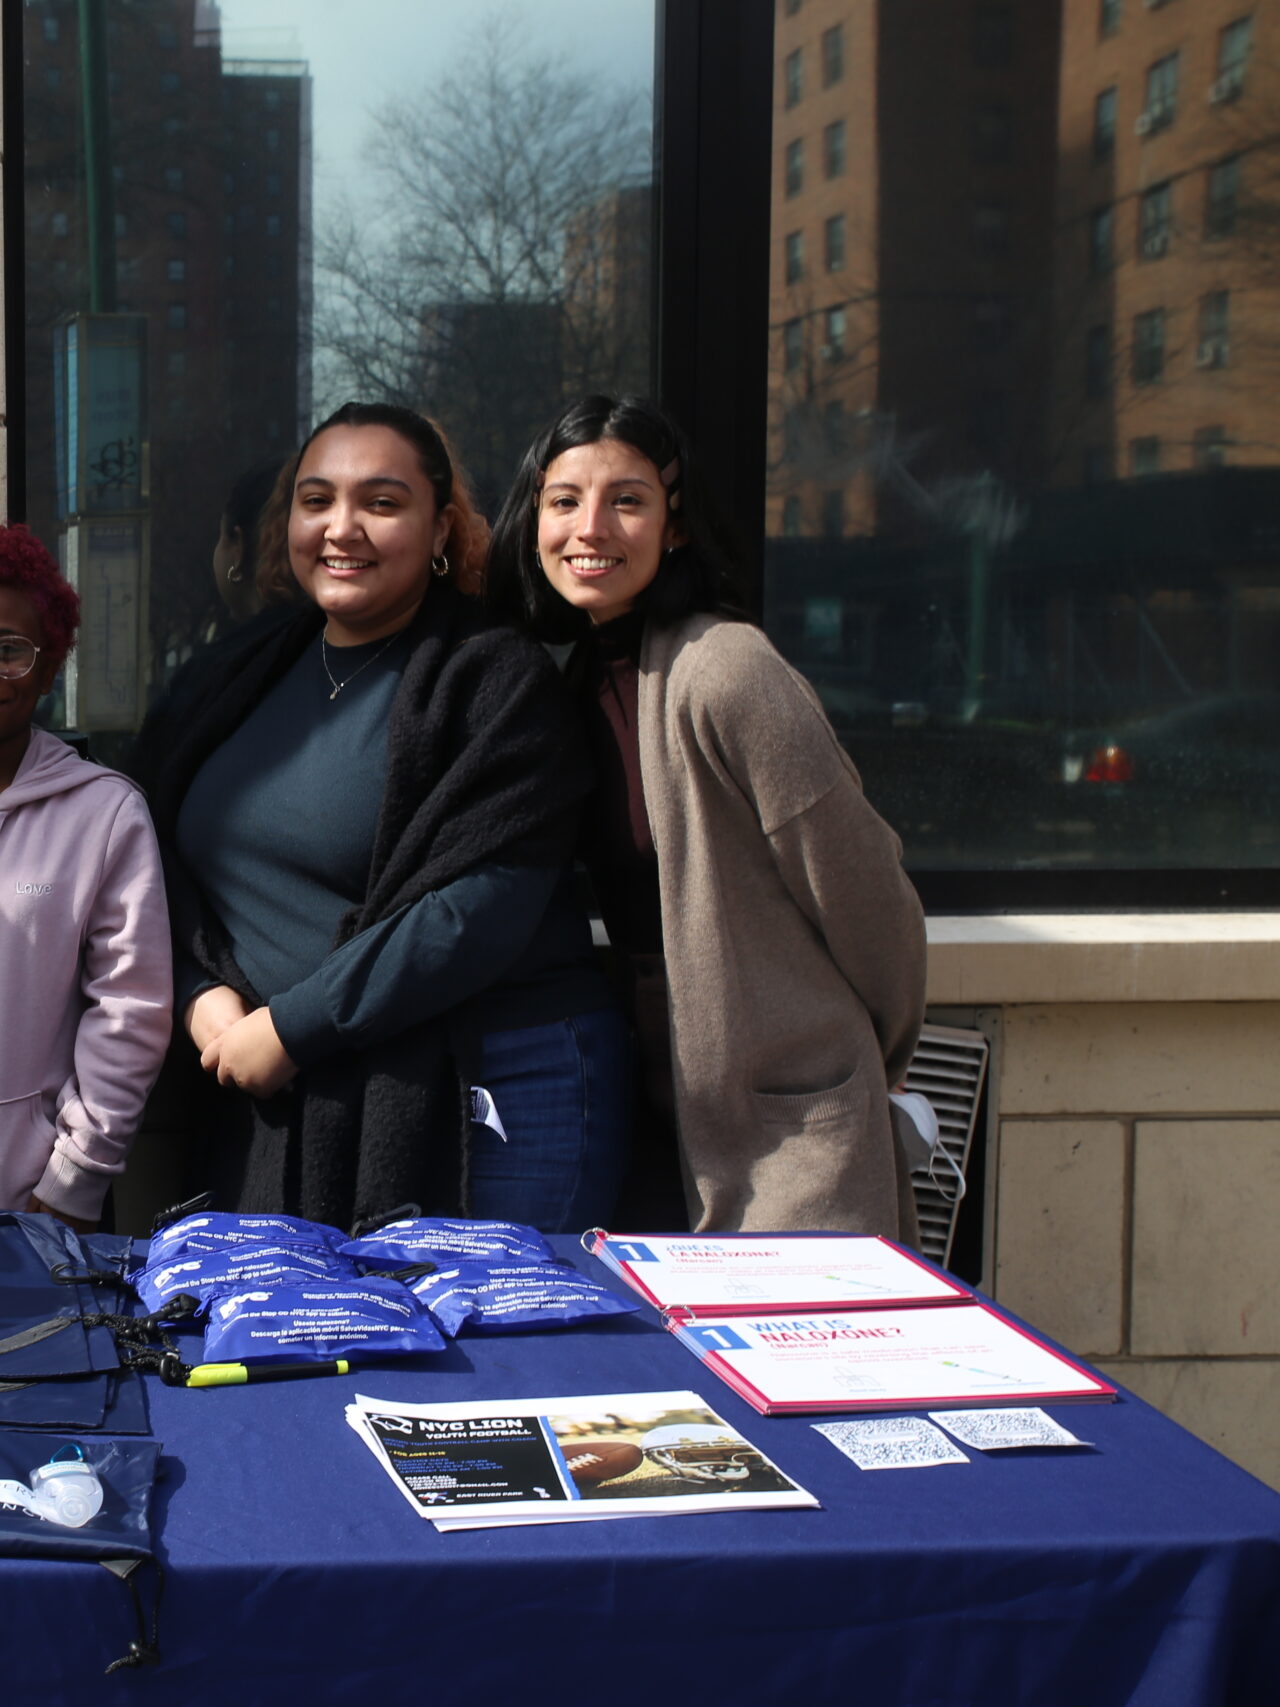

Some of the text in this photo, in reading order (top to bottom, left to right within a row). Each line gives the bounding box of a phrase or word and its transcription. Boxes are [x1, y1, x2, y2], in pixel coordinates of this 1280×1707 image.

[624, 1245, 641, 1260] 1
[747, 1319, 852, 1332] WHAT IS
[701, 1329, 733, 1348] 1
[759, 1328, 906, 1343] NALOXONE?
[420, 1419, 523, 1432] NYC LION
[425, 1429, 532, 1439] YOUTH FOOTBALL
